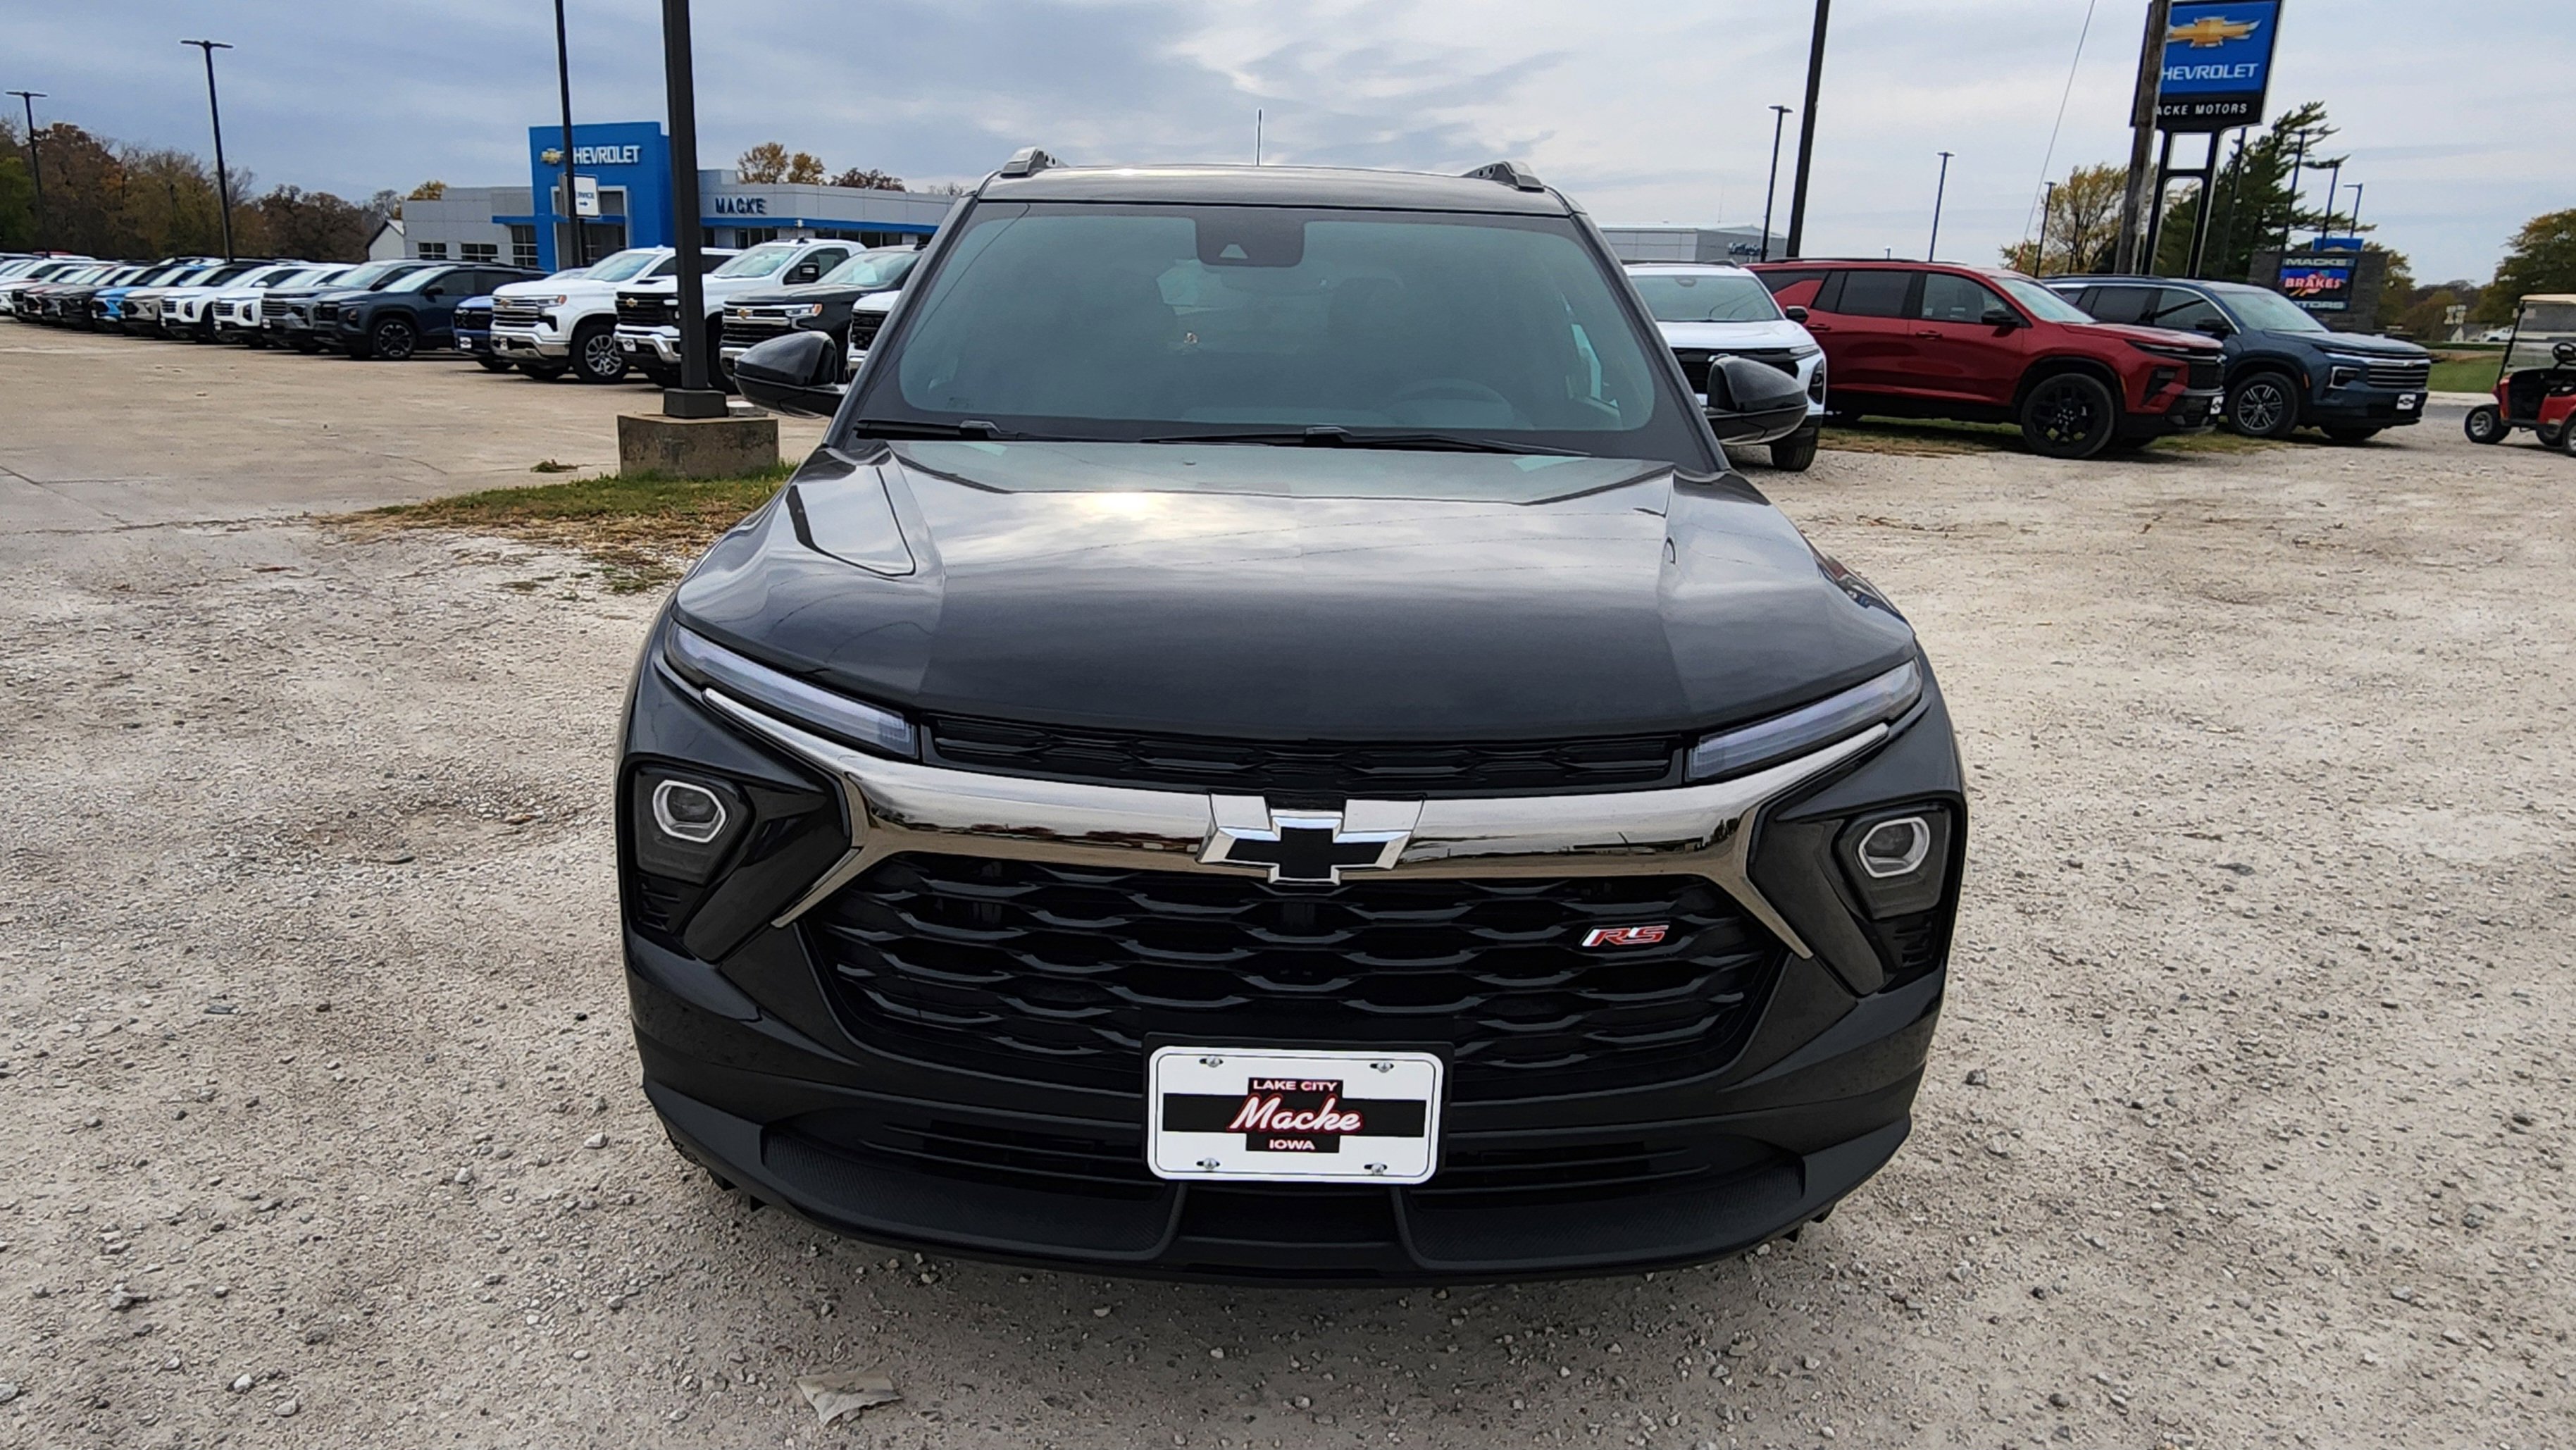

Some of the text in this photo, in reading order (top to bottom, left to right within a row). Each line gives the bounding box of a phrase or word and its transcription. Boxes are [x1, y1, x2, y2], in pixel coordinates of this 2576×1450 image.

[2161, 63, 2259, 81] HEVROLET
[2155, 104, 2248, 116] ACKE MOTORS
[573, 146, 640, 164] HEVROLET
[715, 197, 767, 215] MACKE
[2284, 277, 2342, 289] BRAKES
[2294, 300, 2344, 309] TORS
[1582, 925, 1669, 947] RS
[1252, 1080, 1338, 1091] LAKE CITY
[1228, 1094, 1362, 1132] Macke
[1269, 1139, 1316, 1151] IOWA
